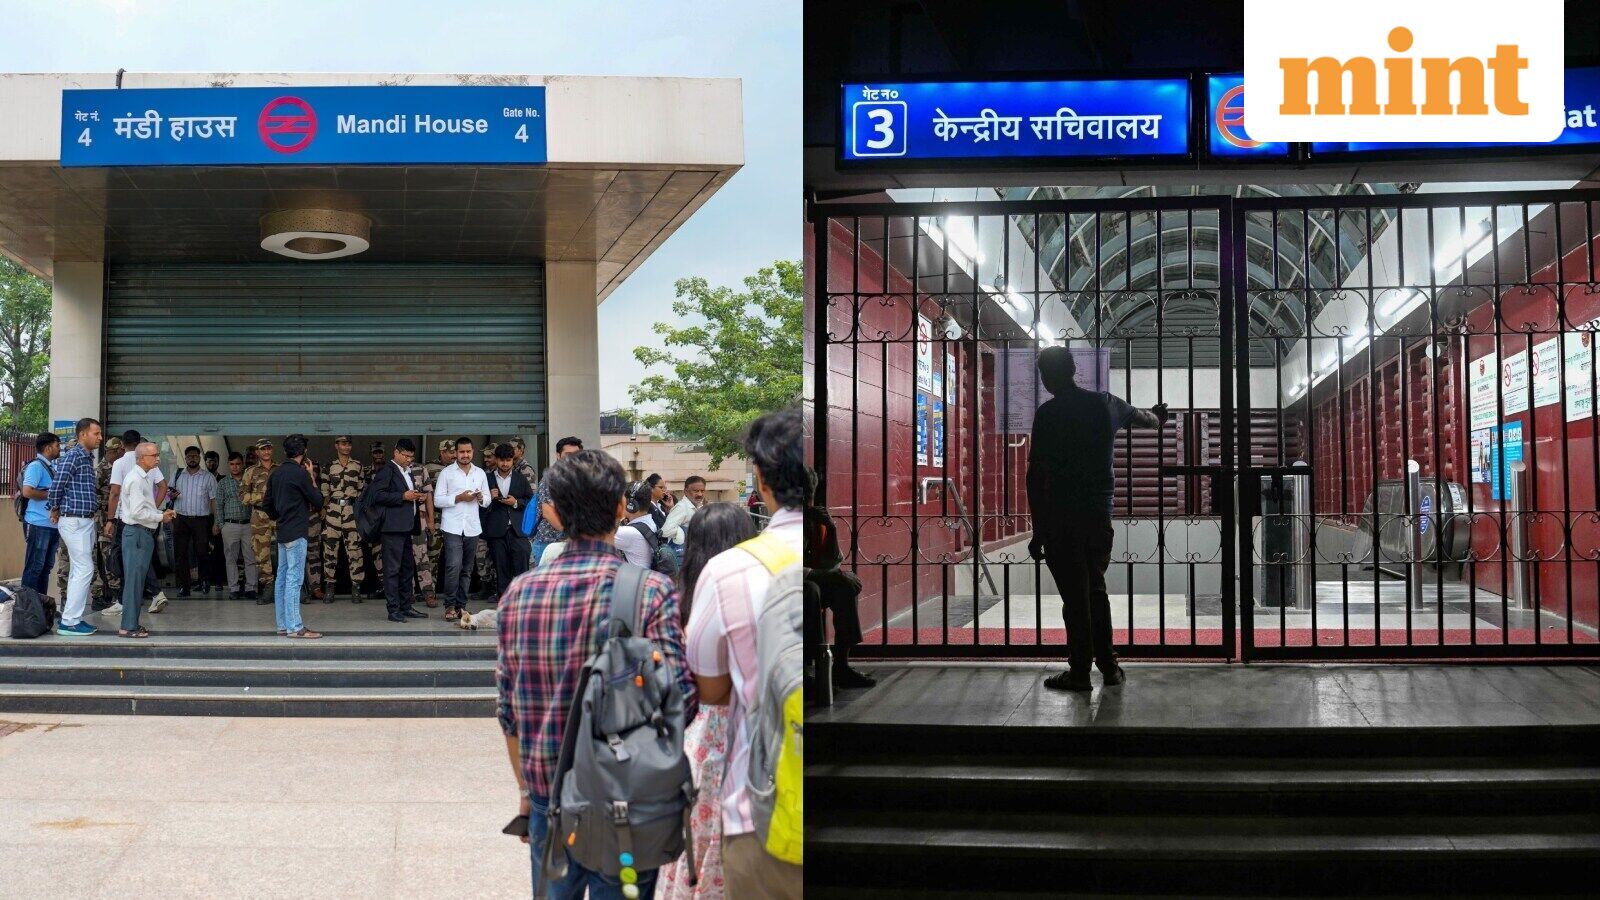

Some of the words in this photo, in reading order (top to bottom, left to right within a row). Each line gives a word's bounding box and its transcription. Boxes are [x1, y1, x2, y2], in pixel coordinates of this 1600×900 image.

[863, 85, 880, 101] गेट
[74, 110, 89, 122] गेट
[503, 107, 523, 118] Gate
[525, 107, 540, 118] No.
[113, 109, 163, 139] मंडी
[169, 116, 237, 141] हाउस
[337, 114, 407, 134] Mandi
[414, 114, 488, 134] House
[514, 123, 529, 143] 4
[867, 108, 895, 149] 3
[933, 107, 1022, 143] केन्द्रीय
[1030, 106, 1162, 140] सचिवालय
[77, 127, 92, 147] 4
